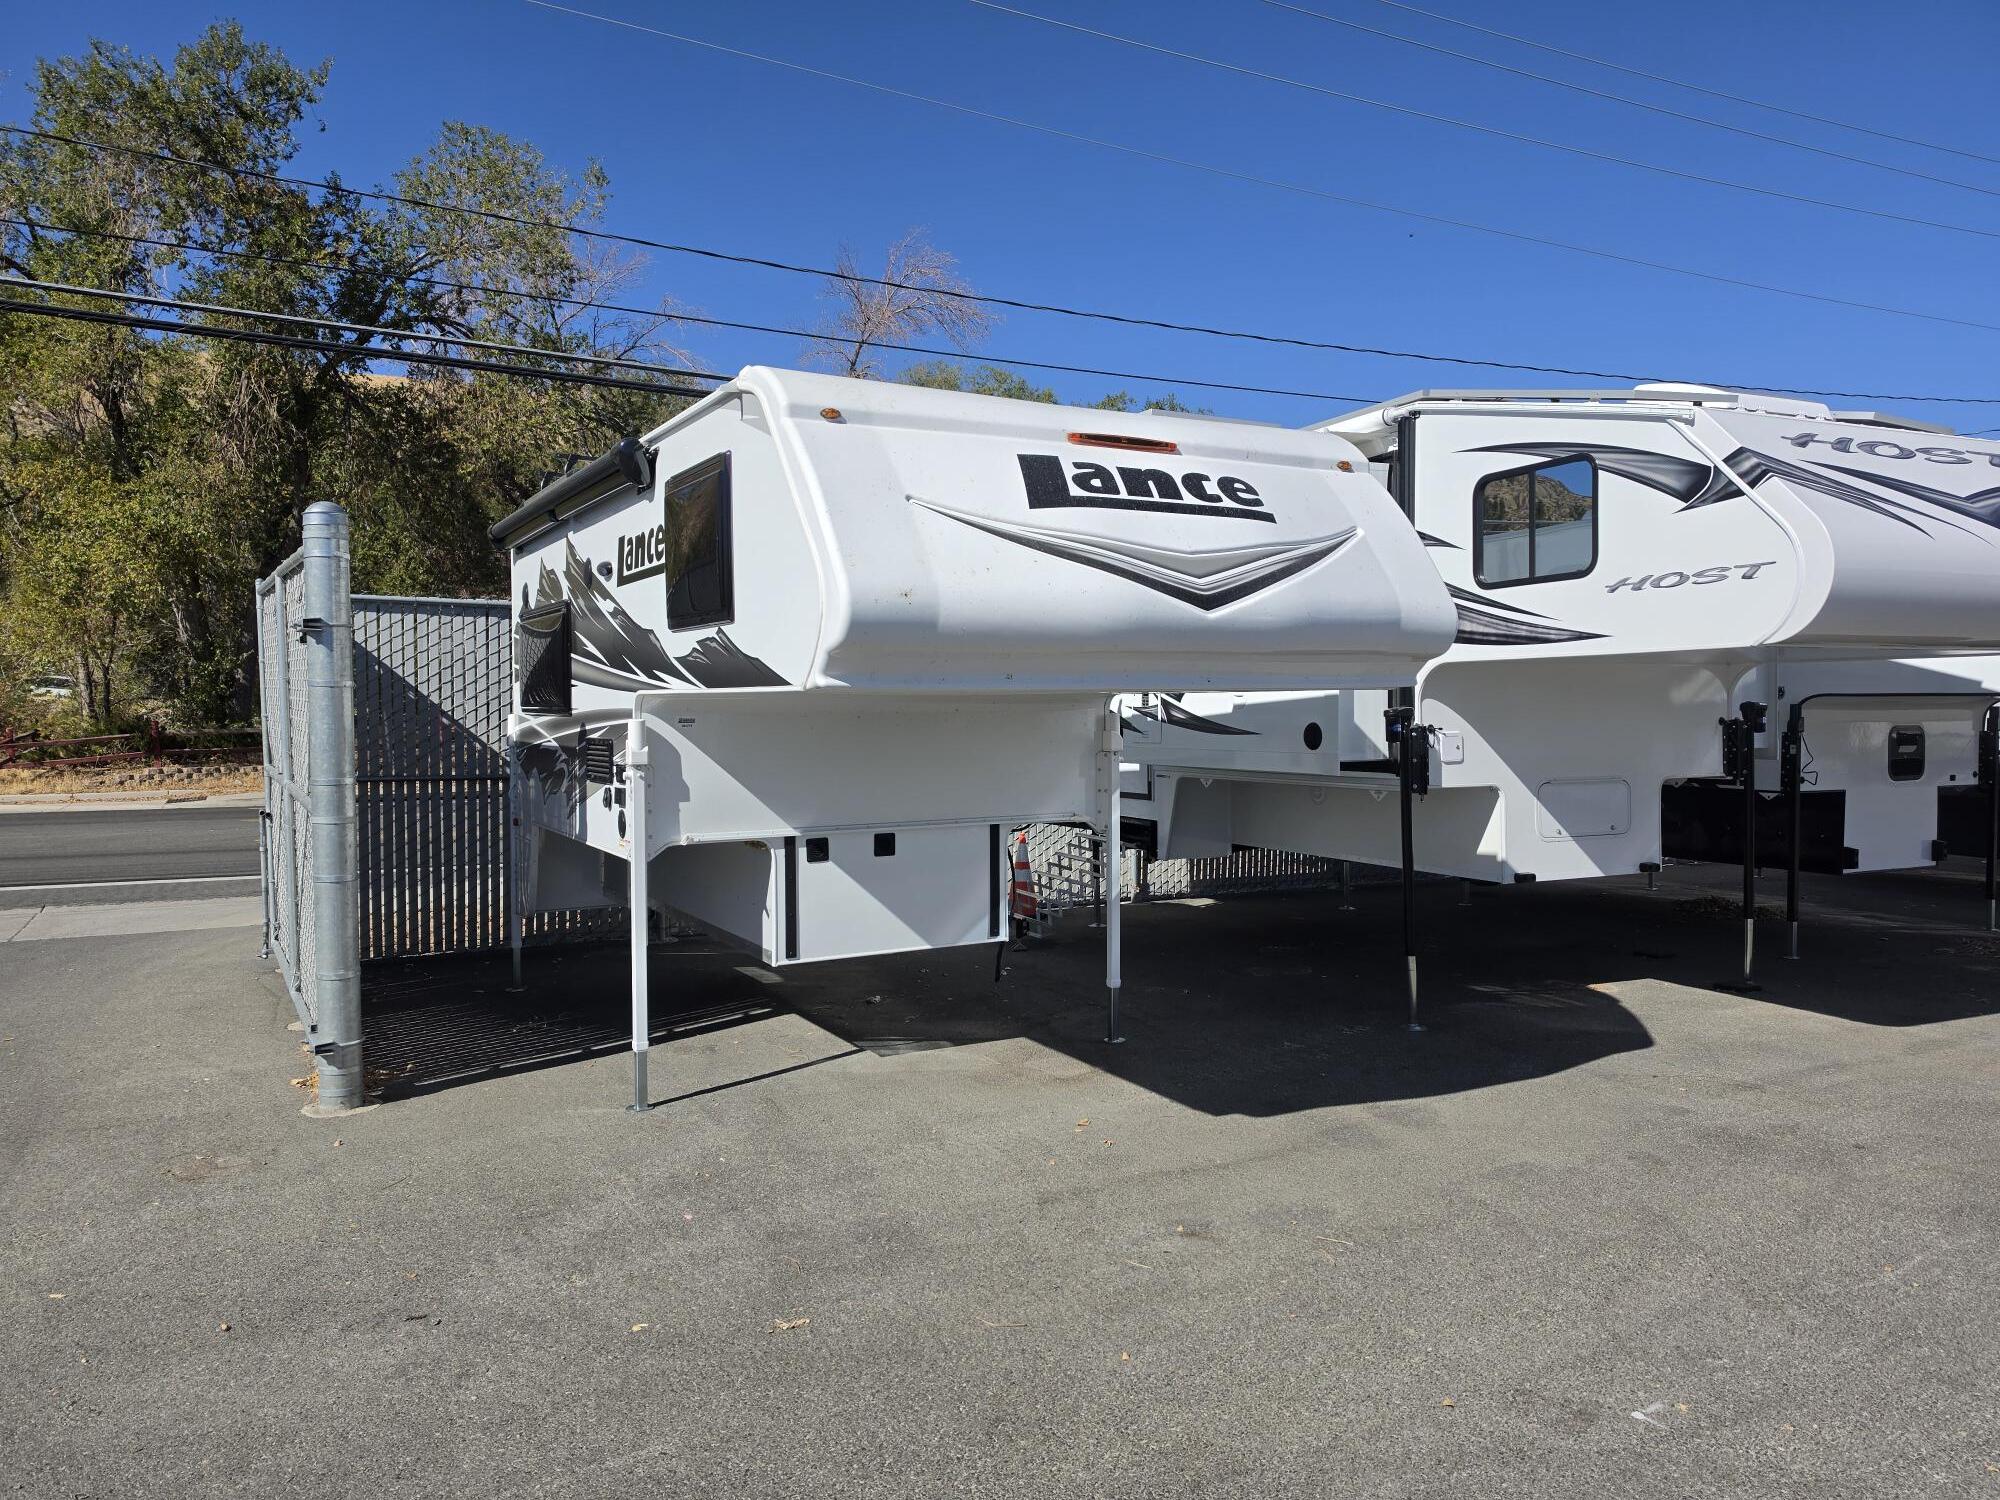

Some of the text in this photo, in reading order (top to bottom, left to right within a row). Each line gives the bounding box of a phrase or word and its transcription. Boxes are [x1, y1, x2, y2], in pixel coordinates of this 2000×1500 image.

[1017, 453, 1277, 524] Lance
[616, 523, 665, 587] Lance
[1605, 561, 1777, 593] HOST
